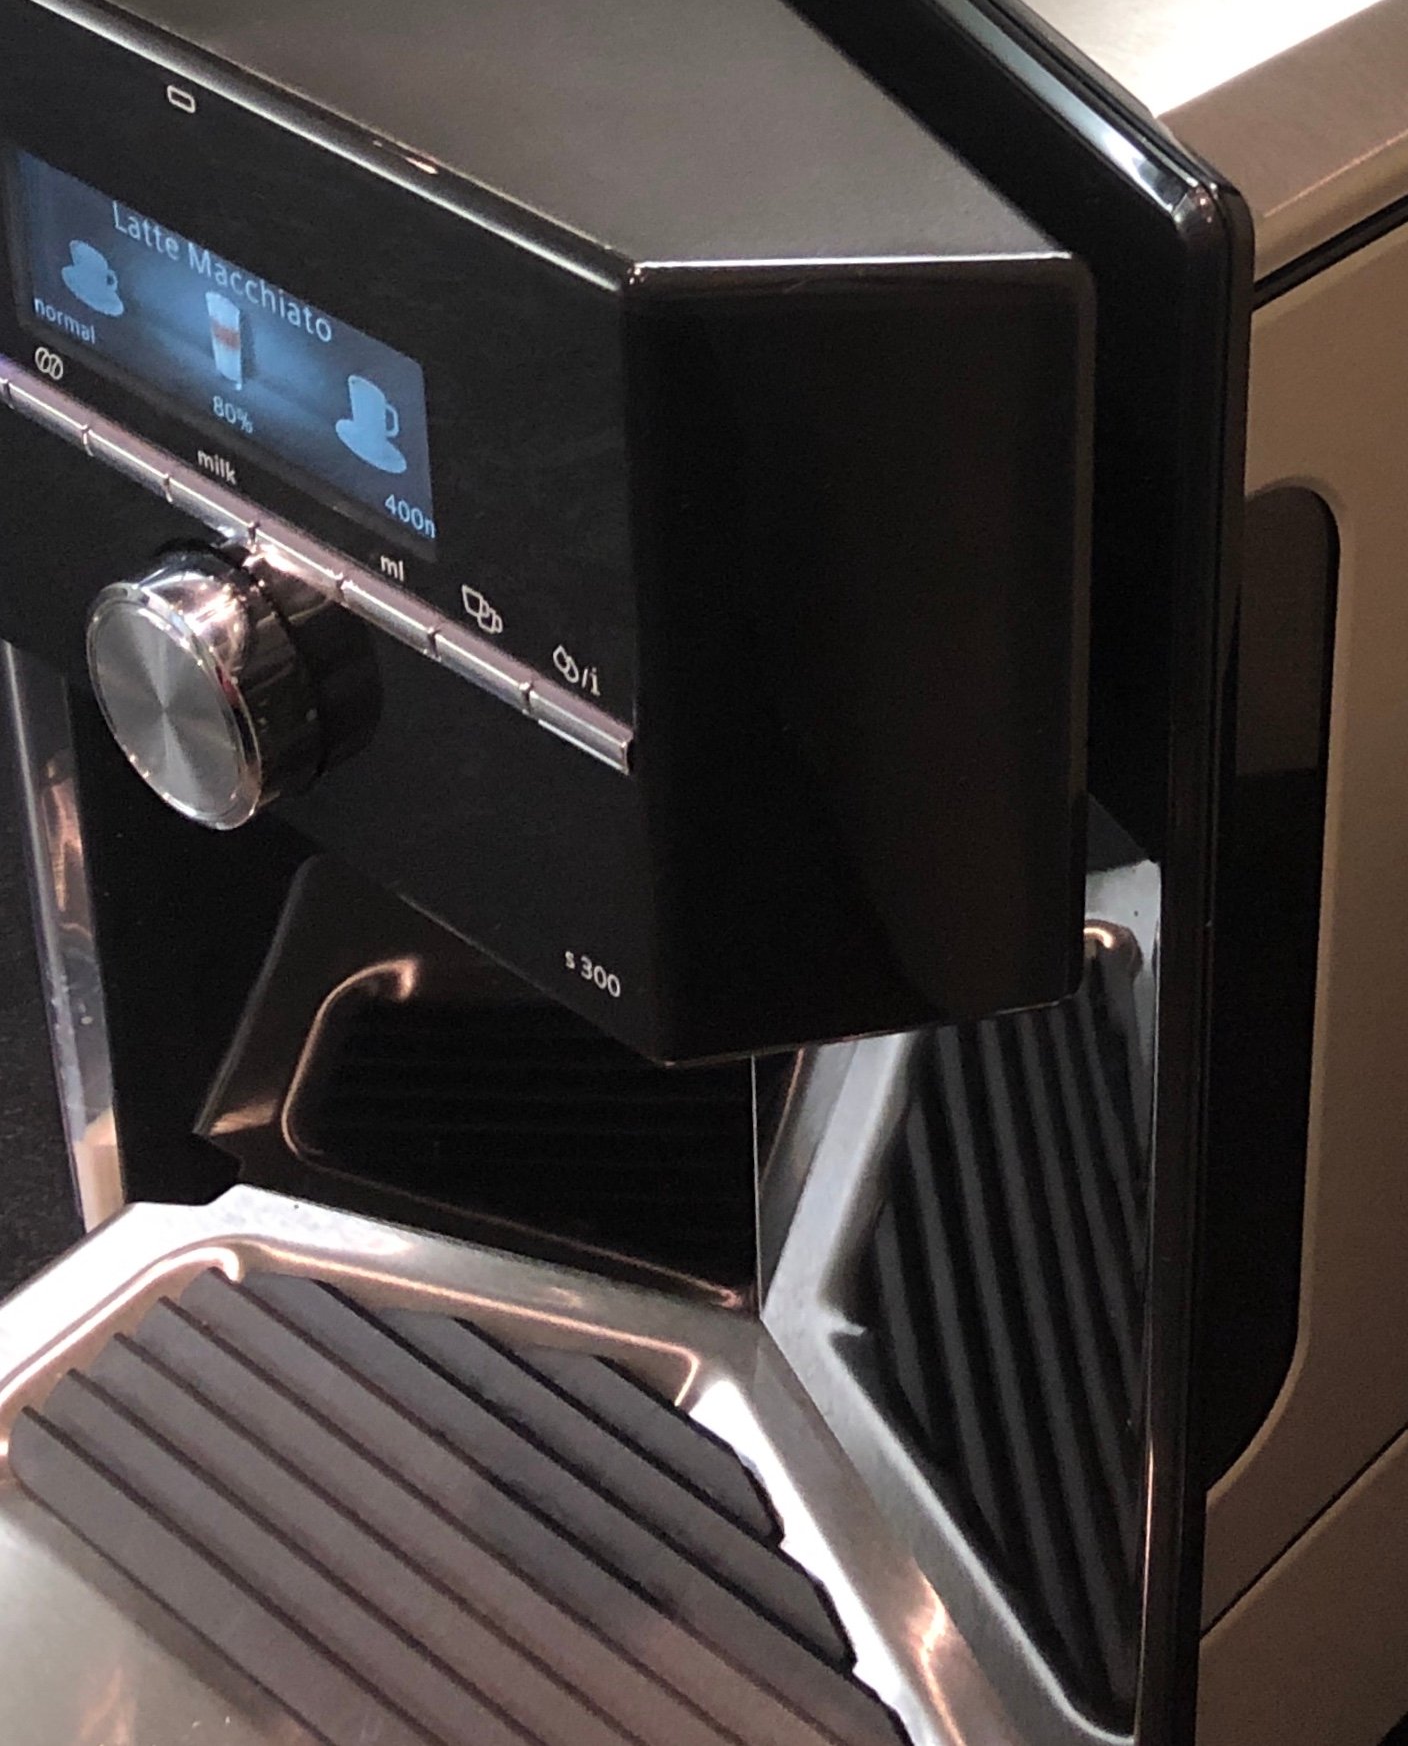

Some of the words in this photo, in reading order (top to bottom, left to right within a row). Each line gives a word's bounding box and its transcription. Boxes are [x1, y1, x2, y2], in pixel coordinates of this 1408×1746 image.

[112, 200, 179, 260] Latte
[188, 242, 332, 343] Macchiato
[34, 297, 96, 345] normal
[212, 395, 254, 434] 80%
[198, 450, 237, 486] milk
[381, 555, 404, 582] ml
[580, 956, 621, 997] 300
